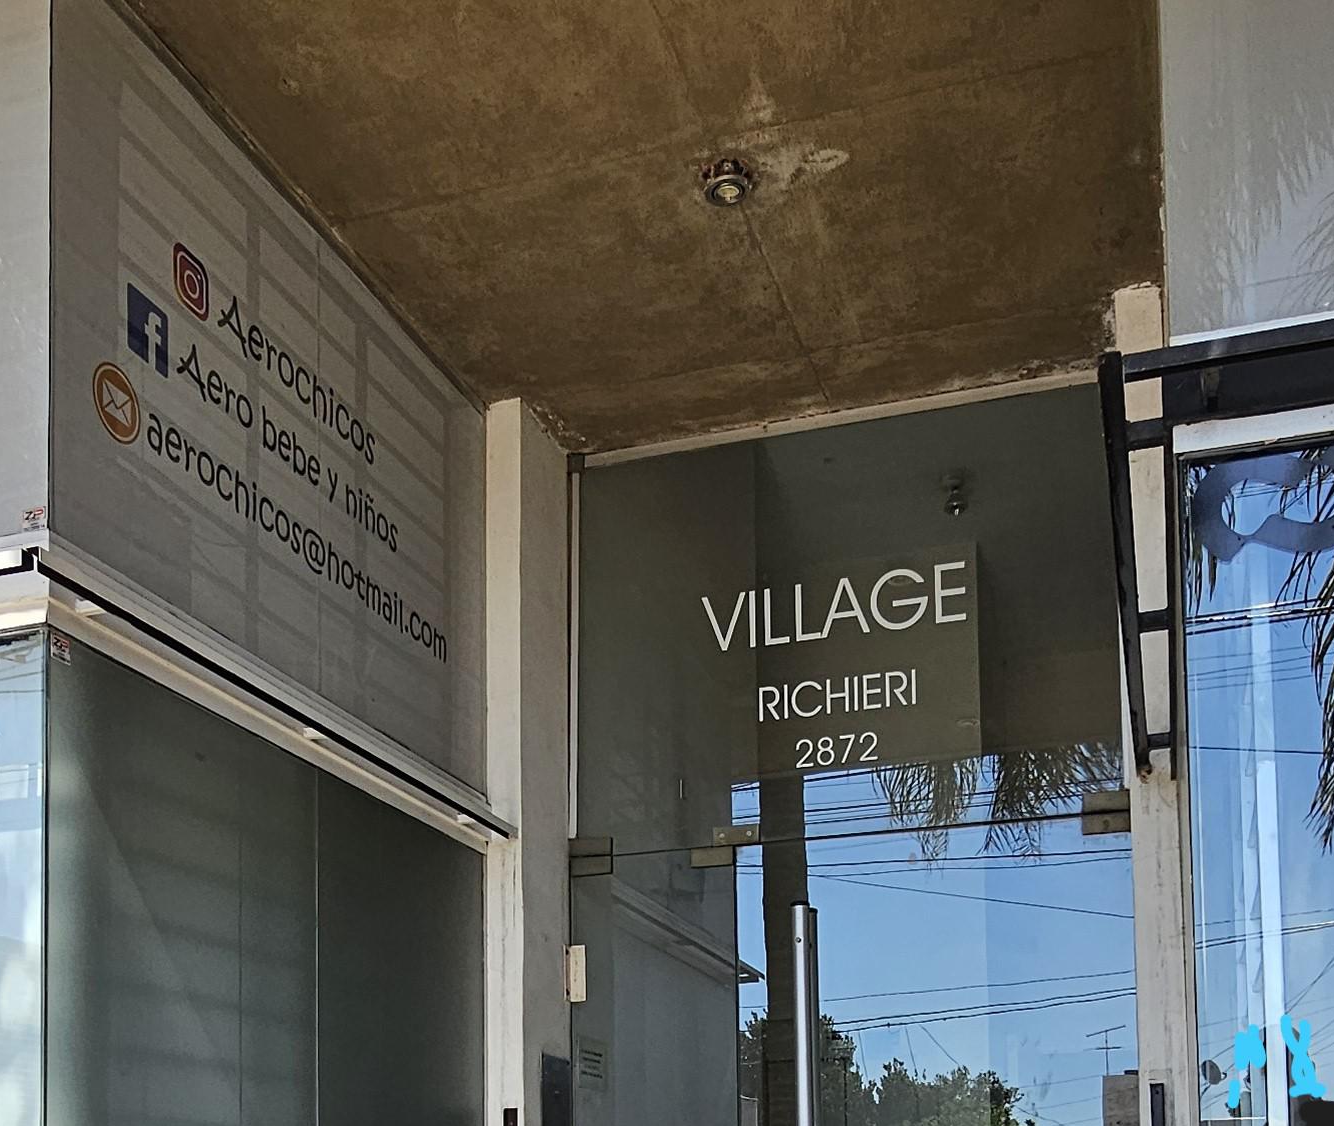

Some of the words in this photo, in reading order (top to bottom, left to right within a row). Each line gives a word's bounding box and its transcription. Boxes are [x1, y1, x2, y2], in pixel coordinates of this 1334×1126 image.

[217, 295, 376, 465] Aerochicos
[177, 344, 254, 429] Aero
[262, 406, 321, 485] bebe
[327, 466, 339, 502] y
[345, 484, 398, 553] niños
[147, 413, 448, 664] aerochicos@hotmail.com
[701, 560, 967, 652] VILLAGE
[758, 668, 917, 722] RICHIERI
[795, 731, 879, 769] 2872
